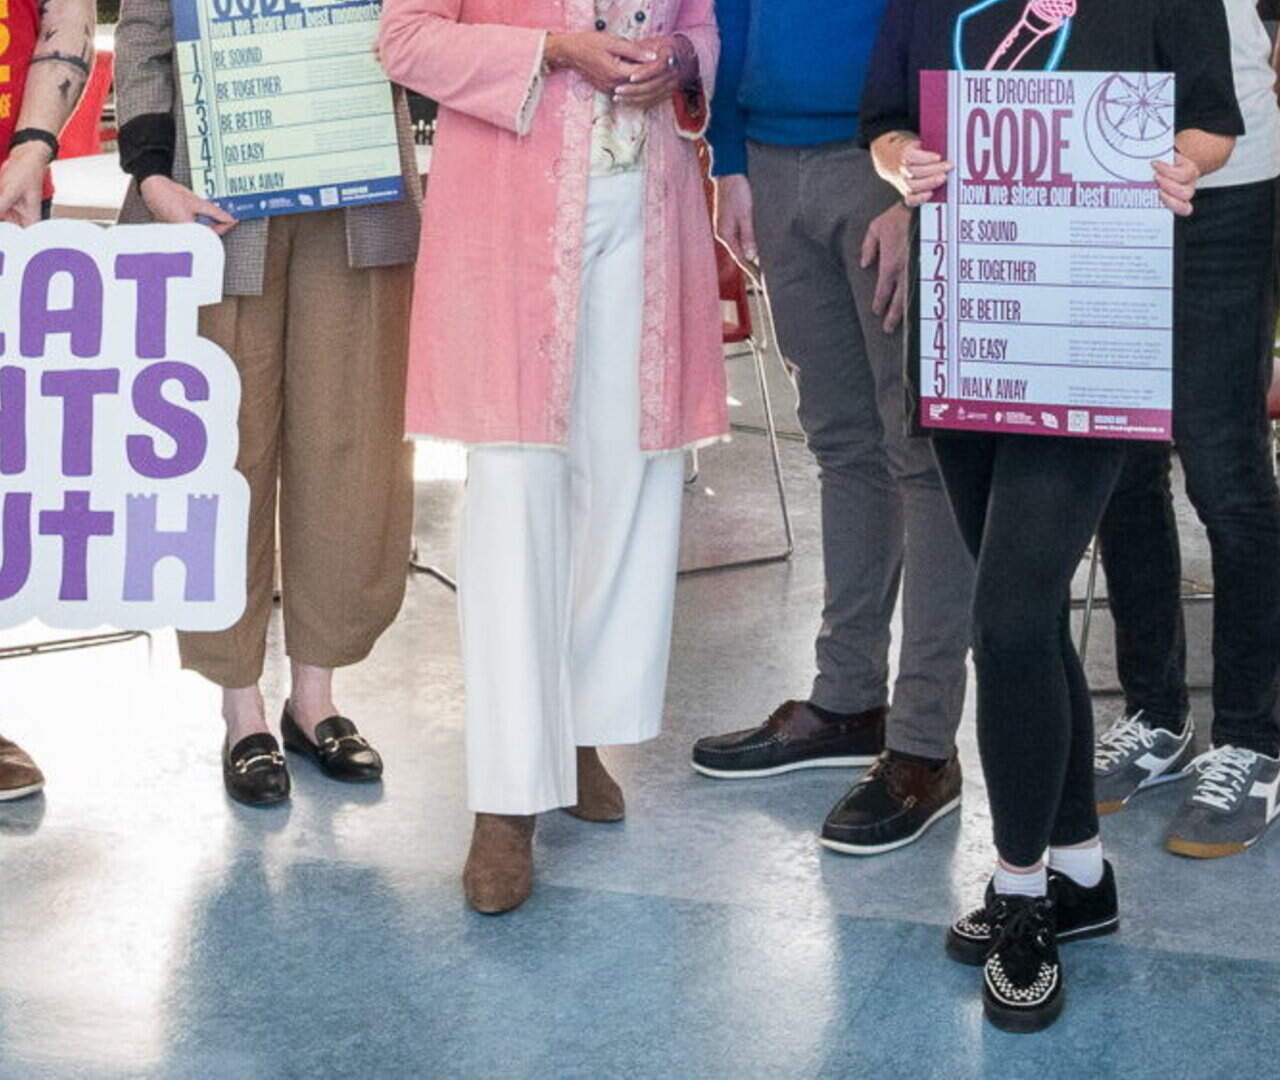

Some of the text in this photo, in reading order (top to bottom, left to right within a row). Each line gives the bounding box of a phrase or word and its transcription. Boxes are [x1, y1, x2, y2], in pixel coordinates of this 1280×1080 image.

[191, 42, 263, 68] 1 BE SOUND
[192, 73, 281, 105] 2 BE TOGETHER
[965, 77, 1075, 104] THE DROGHEDA
[196, 105, 272, 135] 3 BE BETTER
[200, 138, 265, 168] 4 GO EASY
[965, 108, 1073, 182] CODE
[204, 169, 285, 198] 5 WALK AWAY
[961, 183, 987, 205] how
[989, 186, 1008, 205] we
[1011, 183, 1048, 205] share
[1050, 187, 1072, 206] our
[1076, 181, 1106, 207] best
[934, 205, 1018, 242] 1 BE SOUND
[933, 244, 1037, 282] 2 BE TOGETHER
[933, 283, 1021, 321] 3 BE BETTER
[933, 322, 1008, 360] 4 GO EASY
[933, 361, 1028, 401] 5 WALK AWAY
